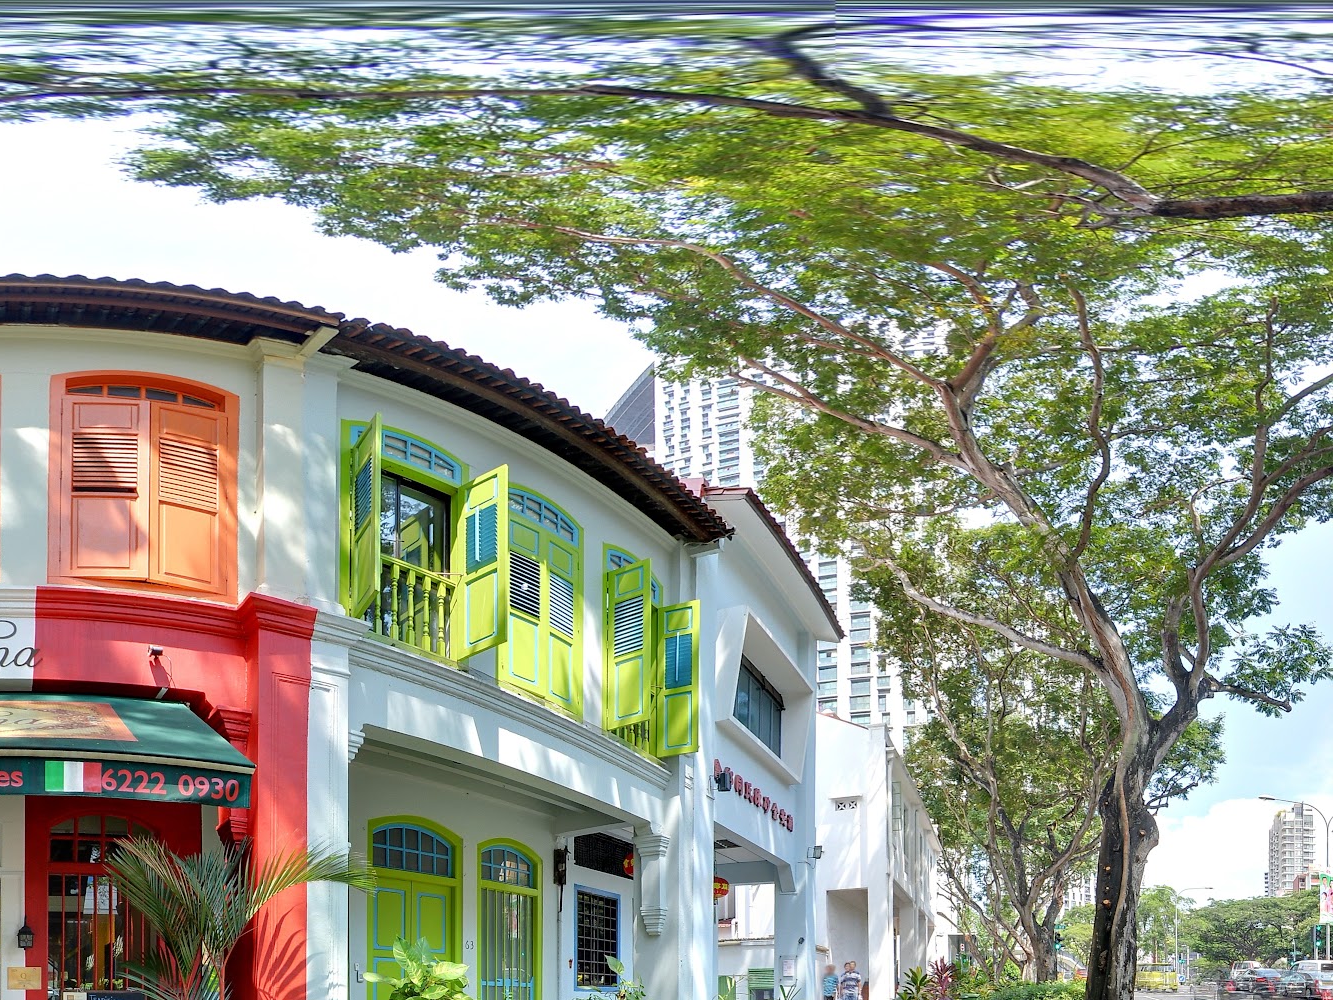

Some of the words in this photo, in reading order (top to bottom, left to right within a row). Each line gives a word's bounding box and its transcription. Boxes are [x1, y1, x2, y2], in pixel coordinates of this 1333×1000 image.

[101, 768, 167, 795] 6222
[178, 774, 240, 802] 0930
[465, 940, 474, 950] 63
